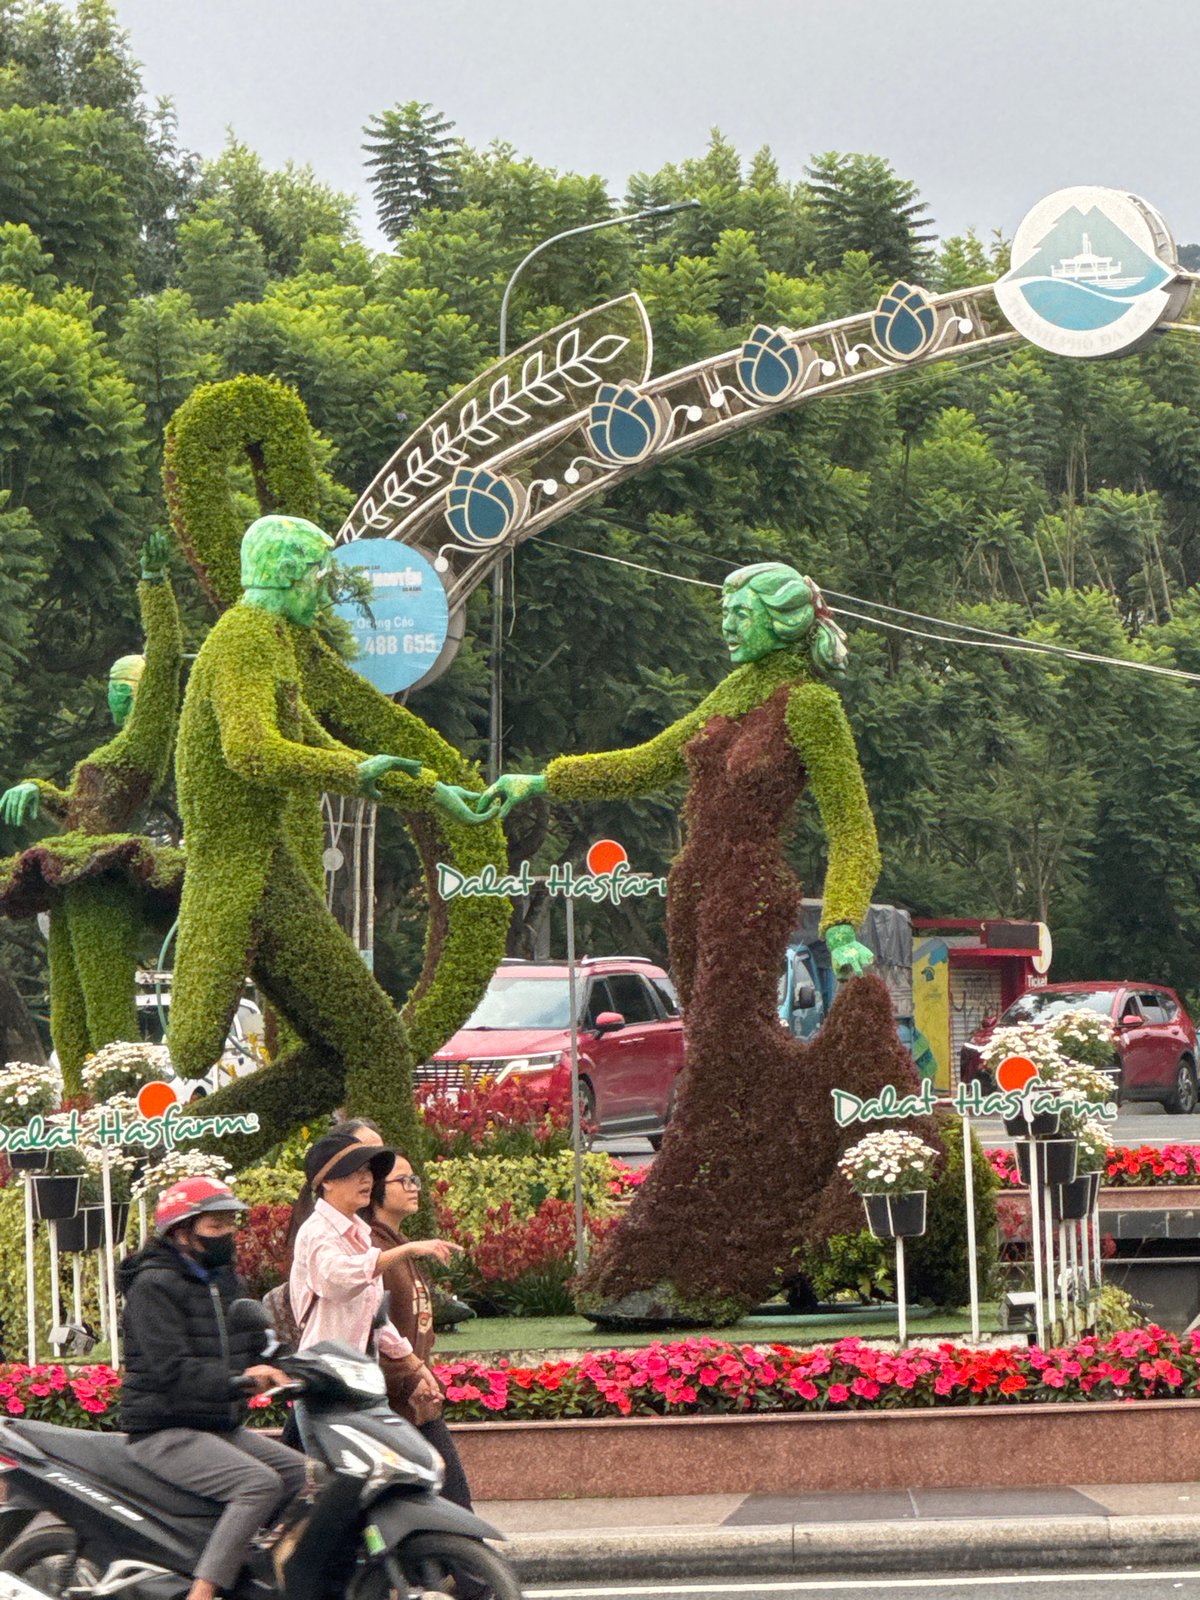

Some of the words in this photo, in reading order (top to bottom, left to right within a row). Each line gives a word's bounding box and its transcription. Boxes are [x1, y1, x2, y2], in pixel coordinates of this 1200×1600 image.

[436, 860, 535, 901] Dalat
[831, 1078, 937, 1127] Dalat
[96, 1103, 260, 1150] Hasfarm
